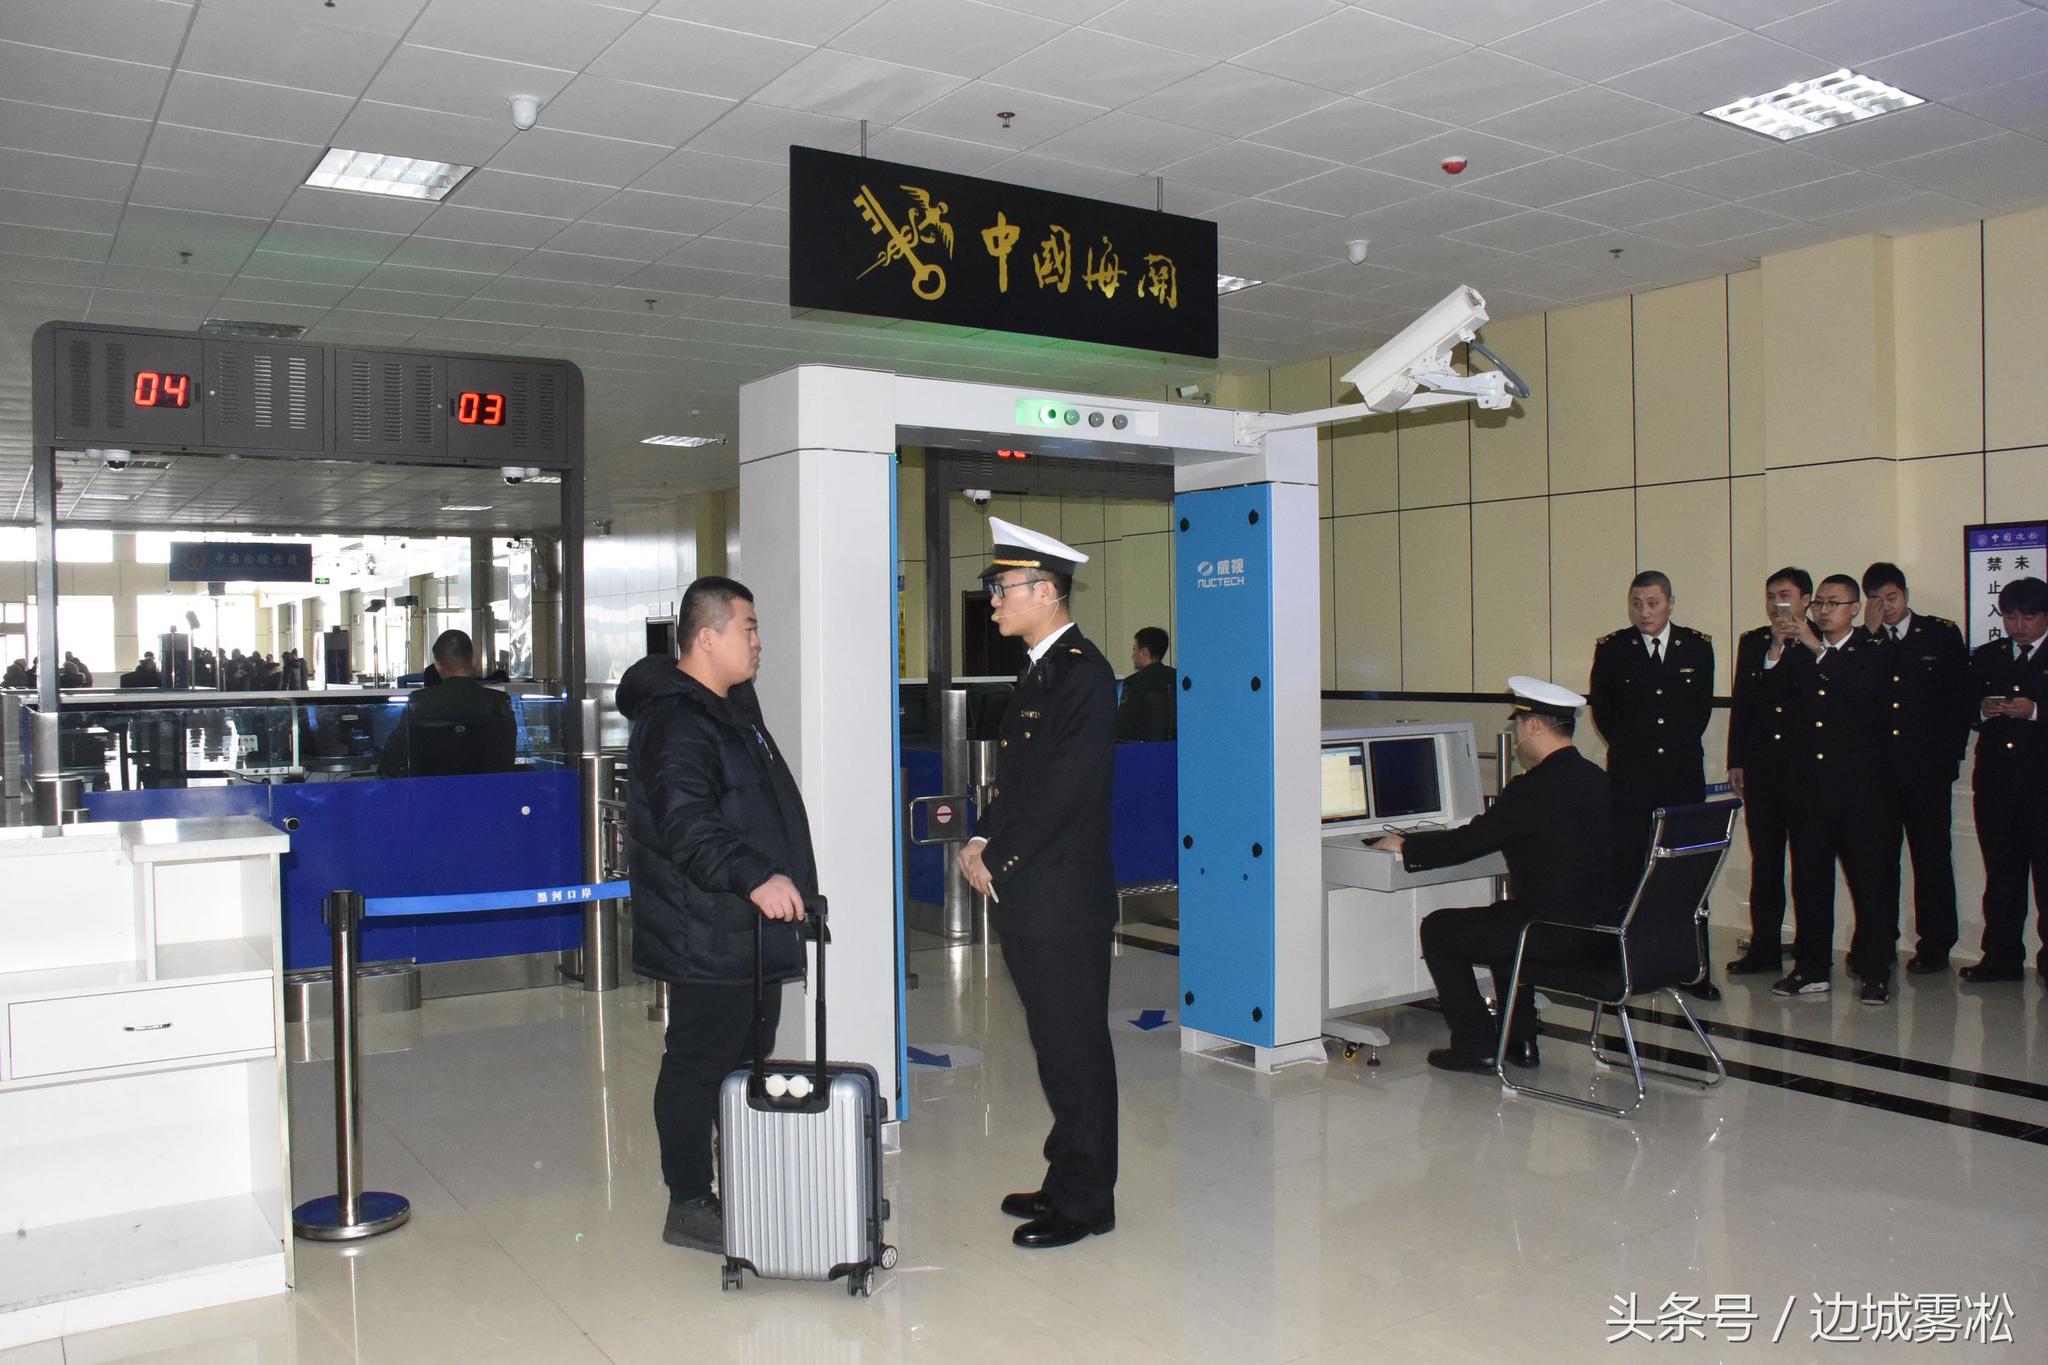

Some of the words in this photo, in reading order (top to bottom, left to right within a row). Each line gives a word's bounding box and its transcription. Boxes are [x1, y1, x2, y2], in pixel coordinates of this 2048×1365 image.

[134, 371, 187, 407] 04
[458, 392, 503, 426] 03
[1197, 576, 1245, 588] NUCTECH
